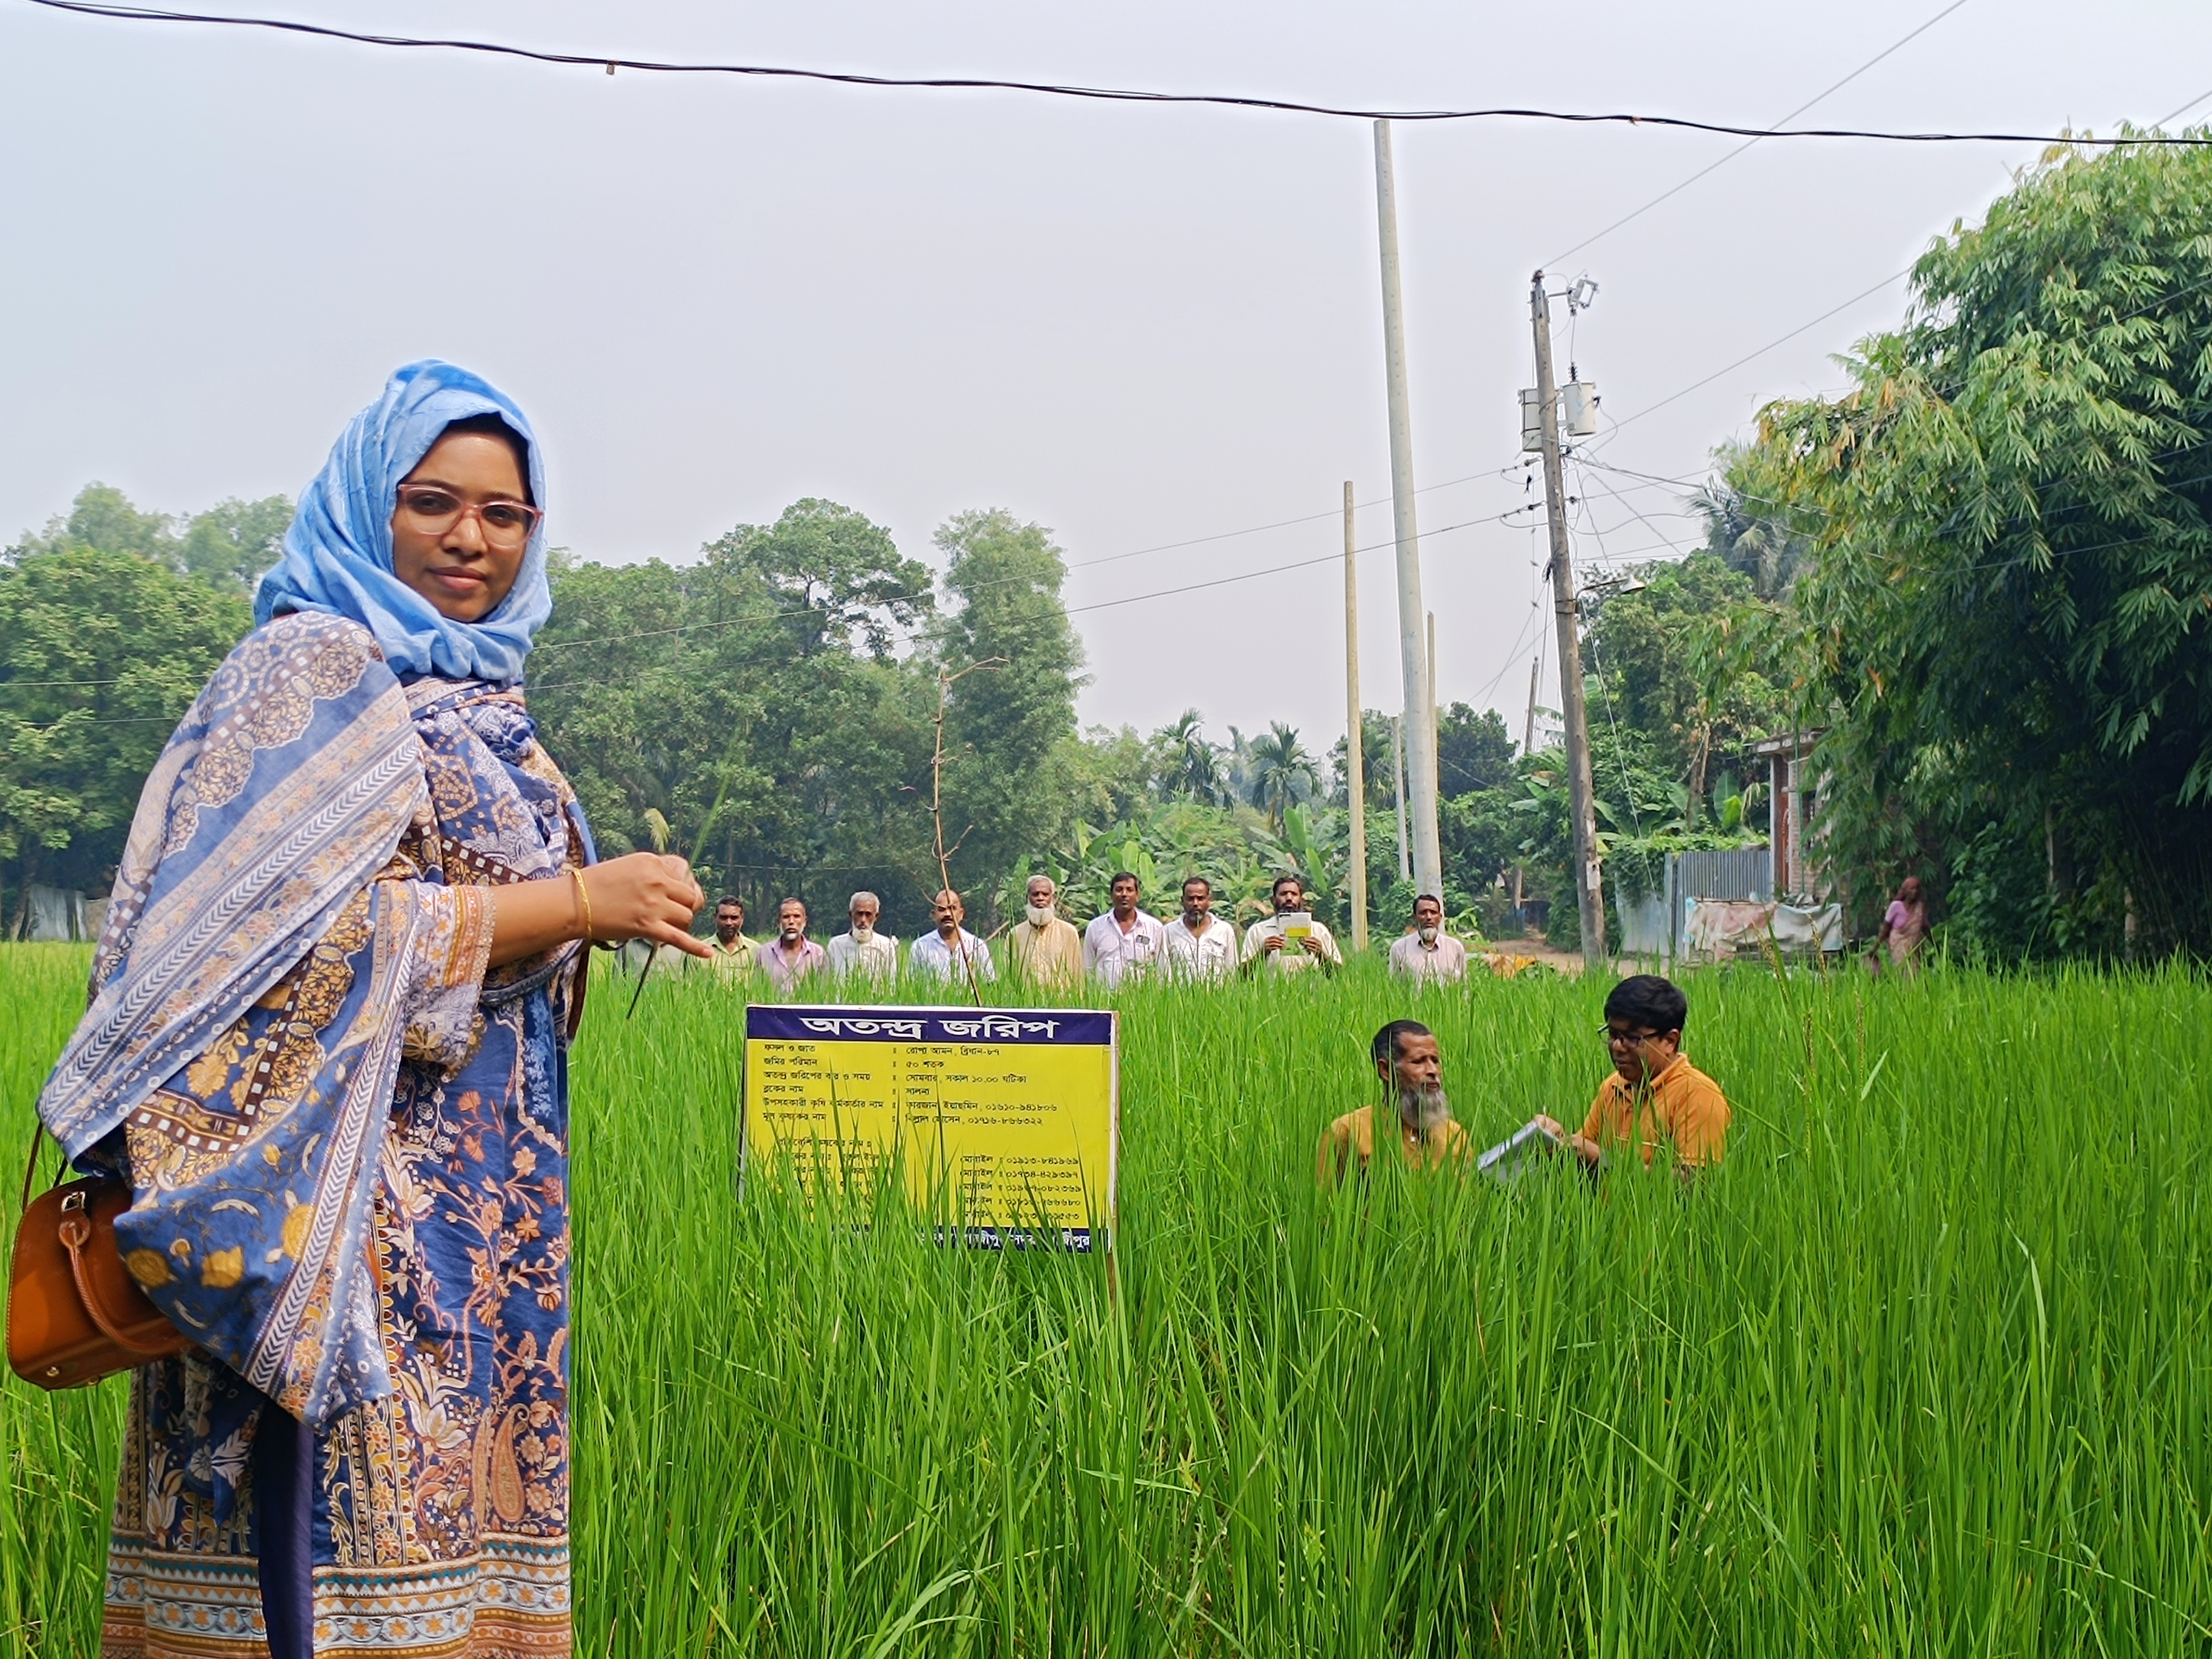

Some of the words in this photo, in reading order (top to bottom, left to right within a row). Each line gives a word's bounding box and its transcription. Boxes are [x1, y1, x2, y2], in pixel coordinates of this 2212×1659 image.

[800, 1018, 928, 1040] অতন্দ্র
[938, 1015, 1060, 1039] জরিপ
[763, 1055, 785, 1065] জমির
[763, 1071, 787, 1079] অতন্দ্র
[790, 1070, 822, 1079] জরিপের
[946, 1075, 968, 1083] সকাল
[1002, 1073, 1027, 1083] ঘটিকা
[763, 1097, 806, 1106] উপসহকারী
[811, 1097, 826, 1110] কৃষি
[906, 1101, 939, 1109] ফারজান
